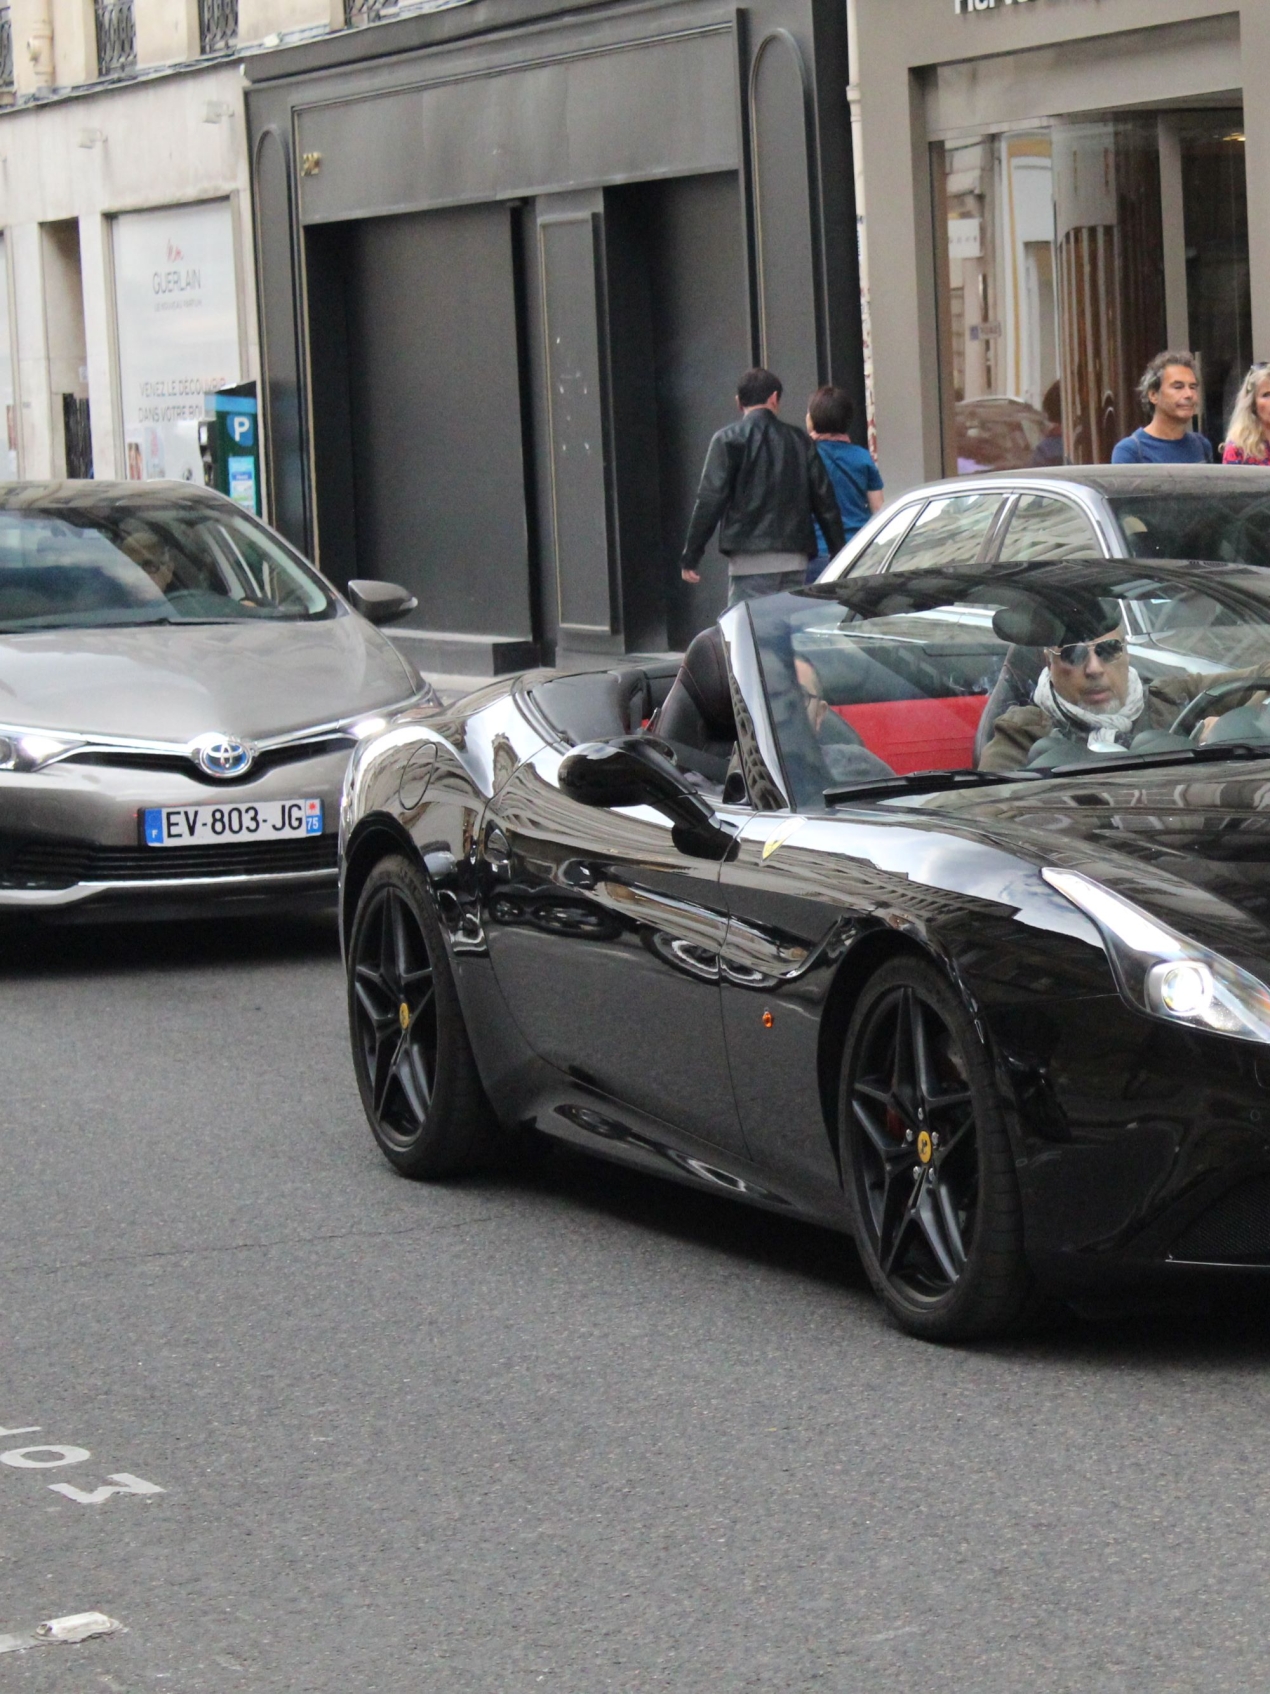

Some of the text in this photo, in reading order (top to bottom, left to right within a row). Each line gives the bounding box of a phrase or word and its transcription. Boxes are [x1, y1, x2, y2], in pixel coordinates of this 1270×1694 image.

[152, 269, 201, 295] GUERLAIN
[139, 381, 165, 398] VENEZ
[167, 380, 177, 396] LE
[138, 406, 160, 423] DANS
[161, 404, 186, 422] VOTRE
[233, 415, 250, 442] P
[166, 803, 303, 839] EV-803-JG
[306, 816, 319, 831] 75
[151, 829, 158, 839] F
